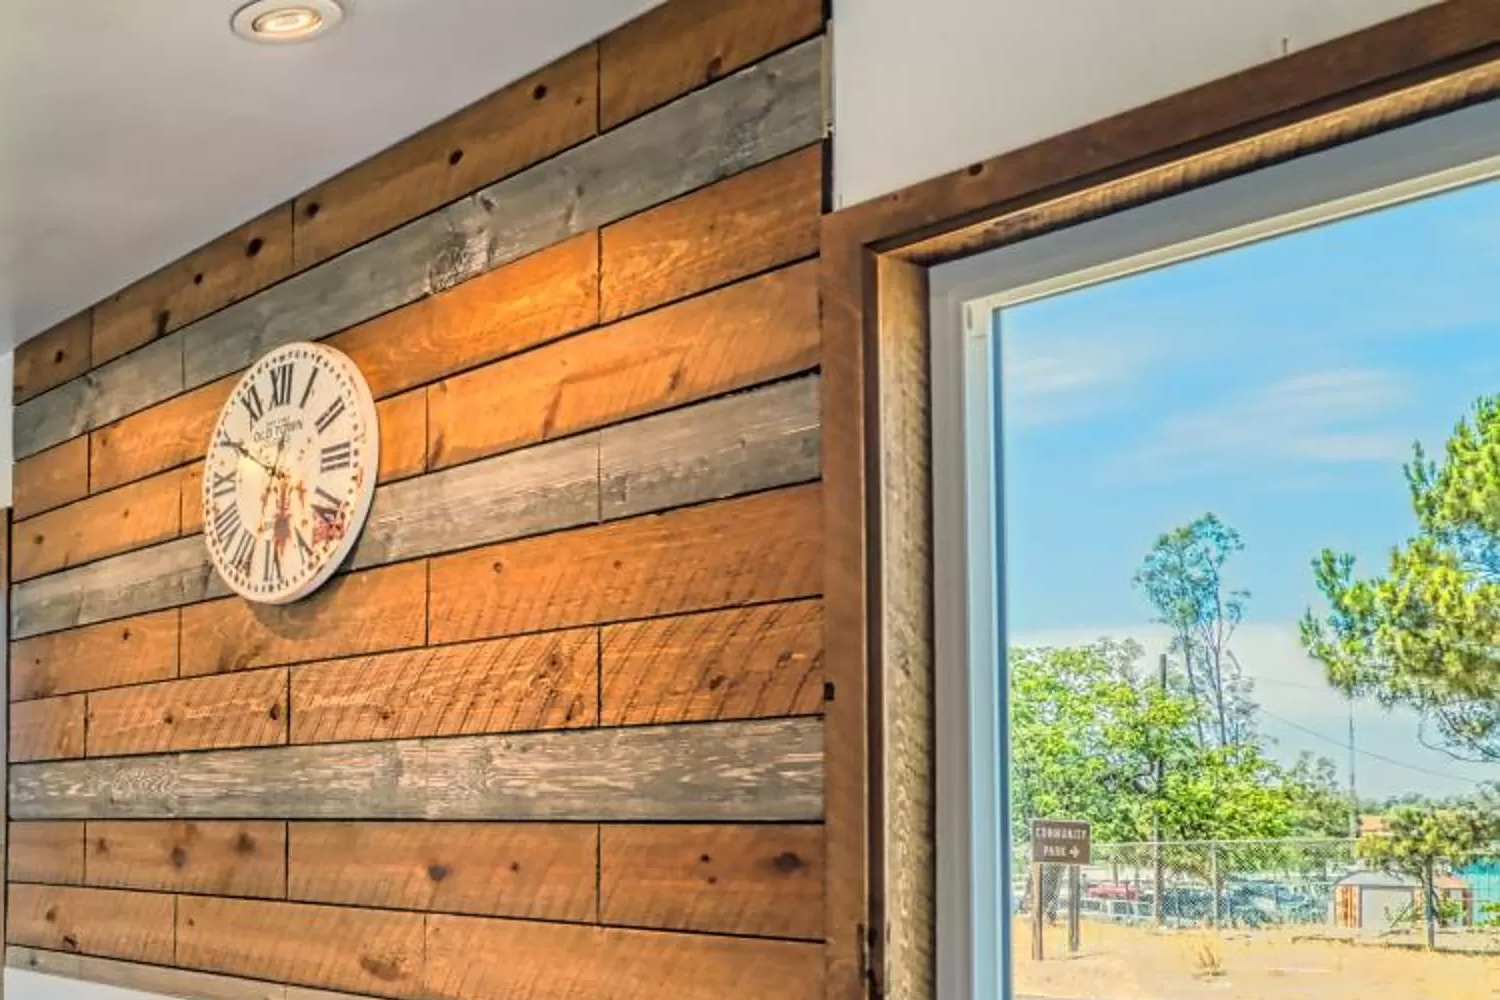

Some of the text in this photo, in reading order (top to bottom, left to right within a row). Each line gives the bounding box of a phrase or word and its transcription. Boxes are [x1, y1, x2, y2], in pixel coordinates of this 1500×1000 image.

[269, 362, 294, 411] XII
[240, 384, 264, 432] XI
[314, 396, 346, 435] II
[320, 441, 351, 474] III
[213, 470, 236, 498] IX
[1035, 827, 1087, 840] COMMUNITY
[1043, 845, 1066, 857] PARK
